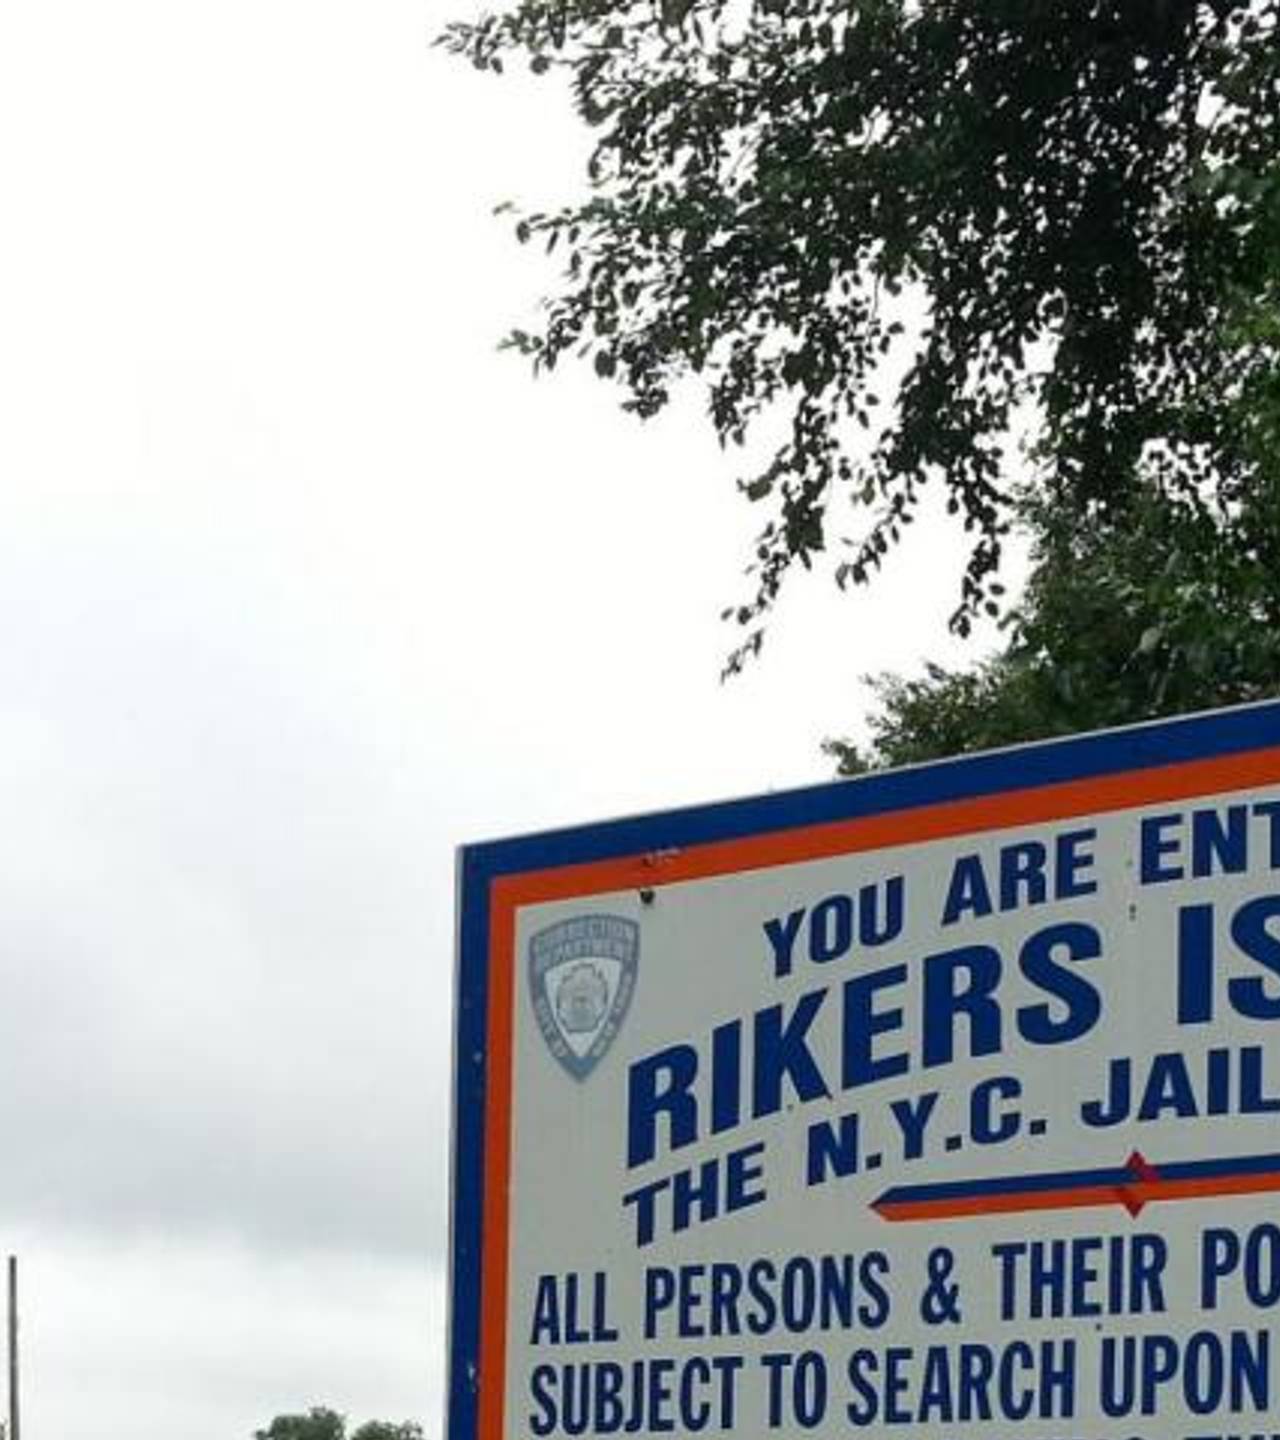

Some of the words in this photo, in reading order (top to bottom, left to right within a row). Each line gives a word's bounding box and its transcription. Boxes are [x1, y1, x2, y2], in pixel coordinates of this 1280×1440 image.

[763, 875, 904, 979] YOU
[941, 828, 1098, 927] ARE
[627, 920, 1102, 1170] RIKERS
[622, 1142, 766, 1248] THE
[807, 1076, 1047, 1186] N.Y.C.
[529, 1272, 619, 1345] ALL
[644, 1251, 890, 1339] PERSONS
[920, 1247, 961, 1325] &
[991, 1233, 1167, 1321] THEIR
[529, 1356, 744, 1437] SUBJECT
[760, 1350, 827, 1429] TO
[847, 1339, 1076, 1426] SEARCH
[1100, 1329, 1269, 1418] UPON
